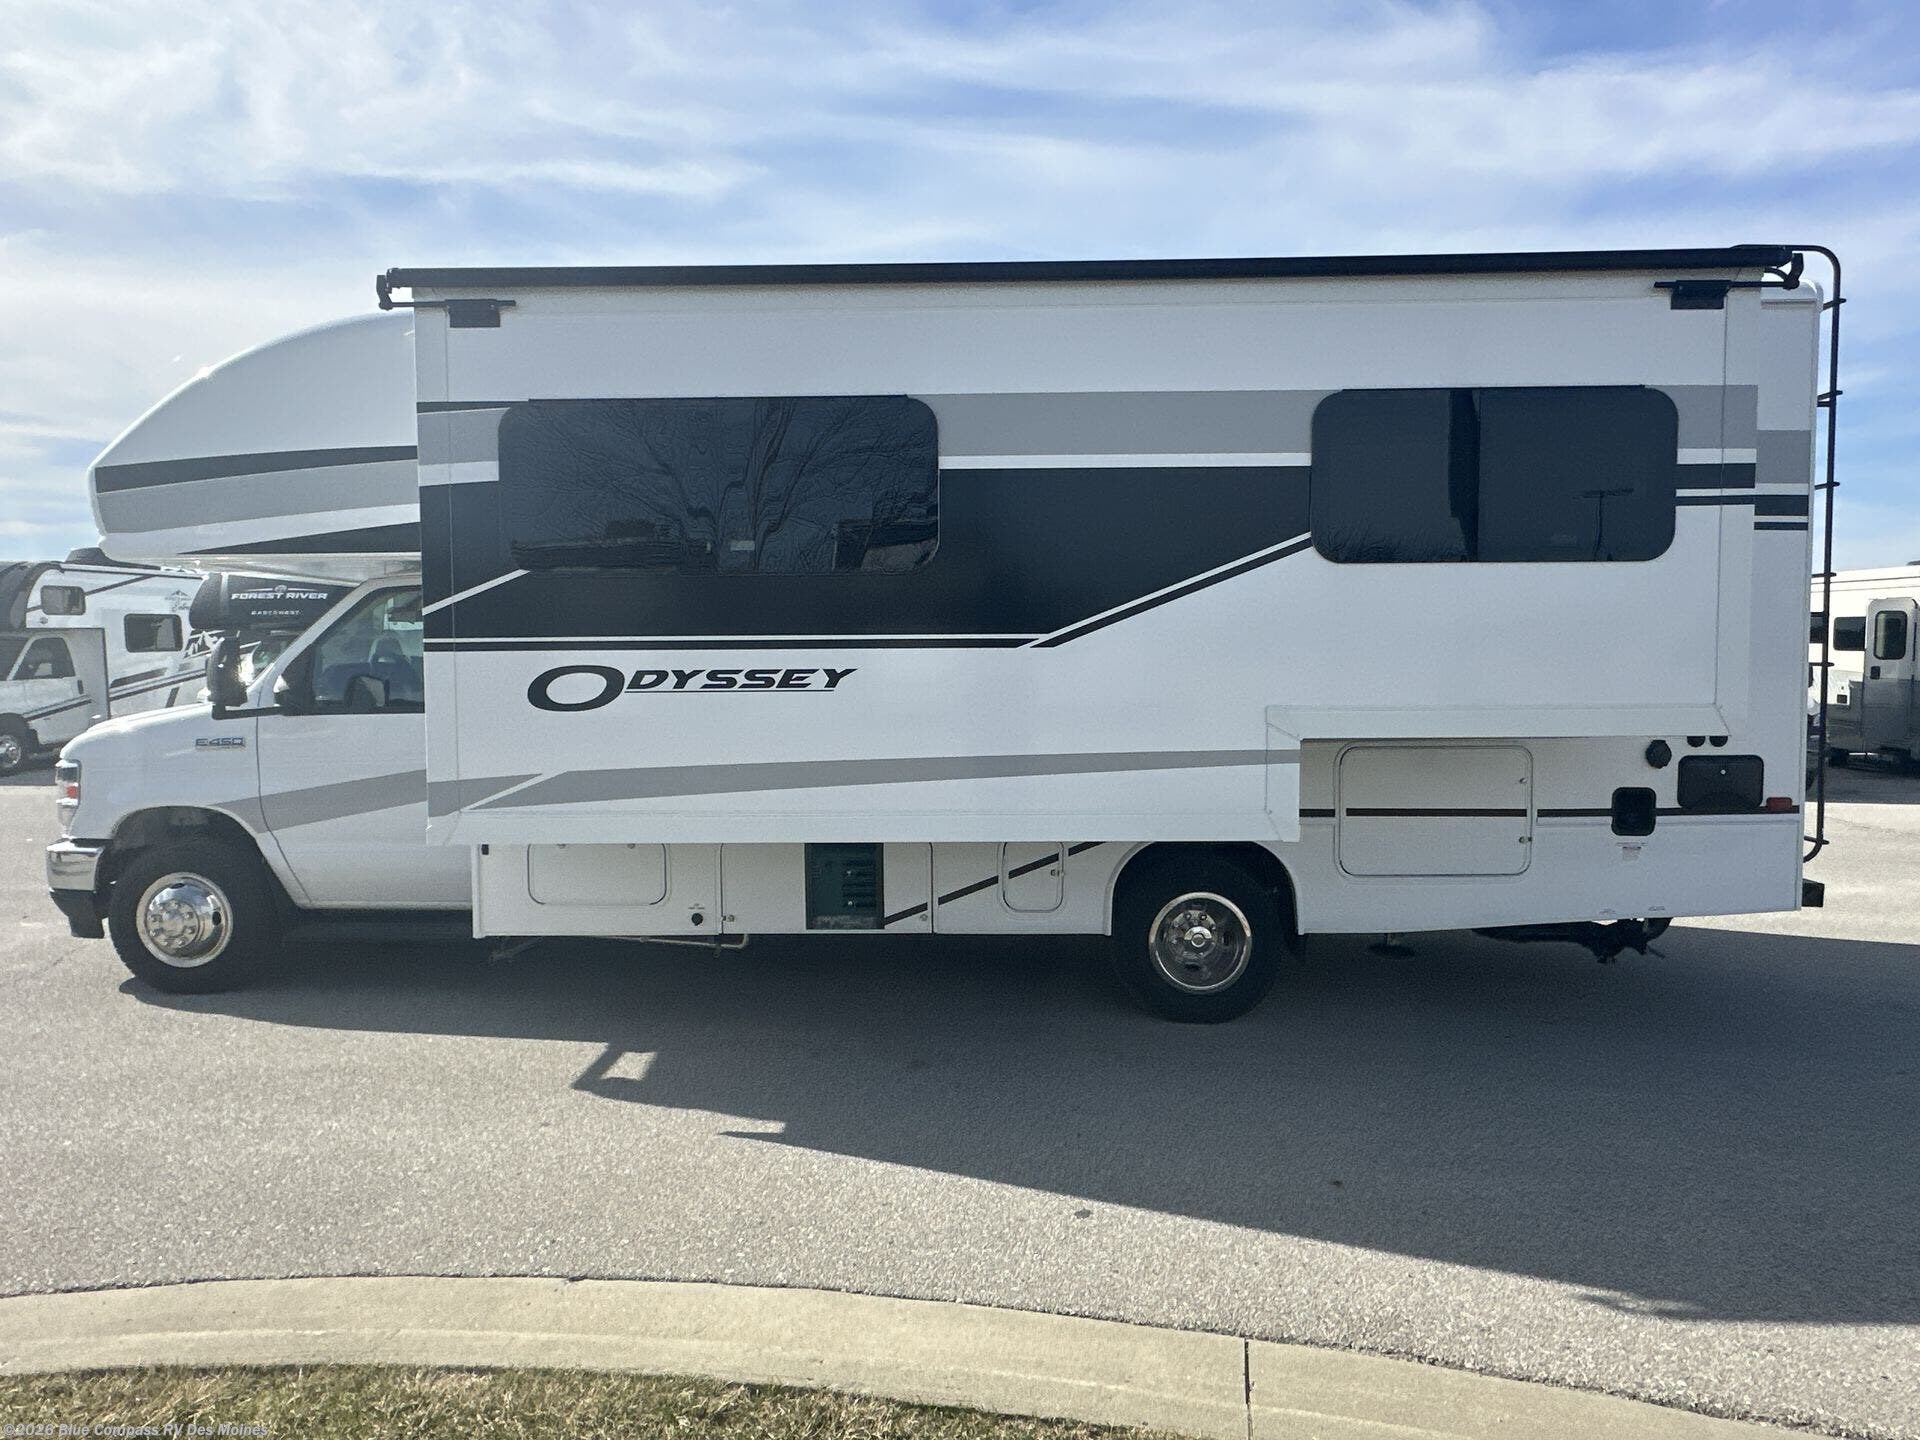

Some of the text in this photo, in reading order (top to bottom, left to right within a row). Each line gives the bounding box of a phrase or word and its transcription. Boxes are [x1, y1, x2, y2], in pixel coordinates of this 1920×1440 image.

[231, 592, 329, 600] FOREST RIVER
[527, 665, 858, 712] ODYSSEY
